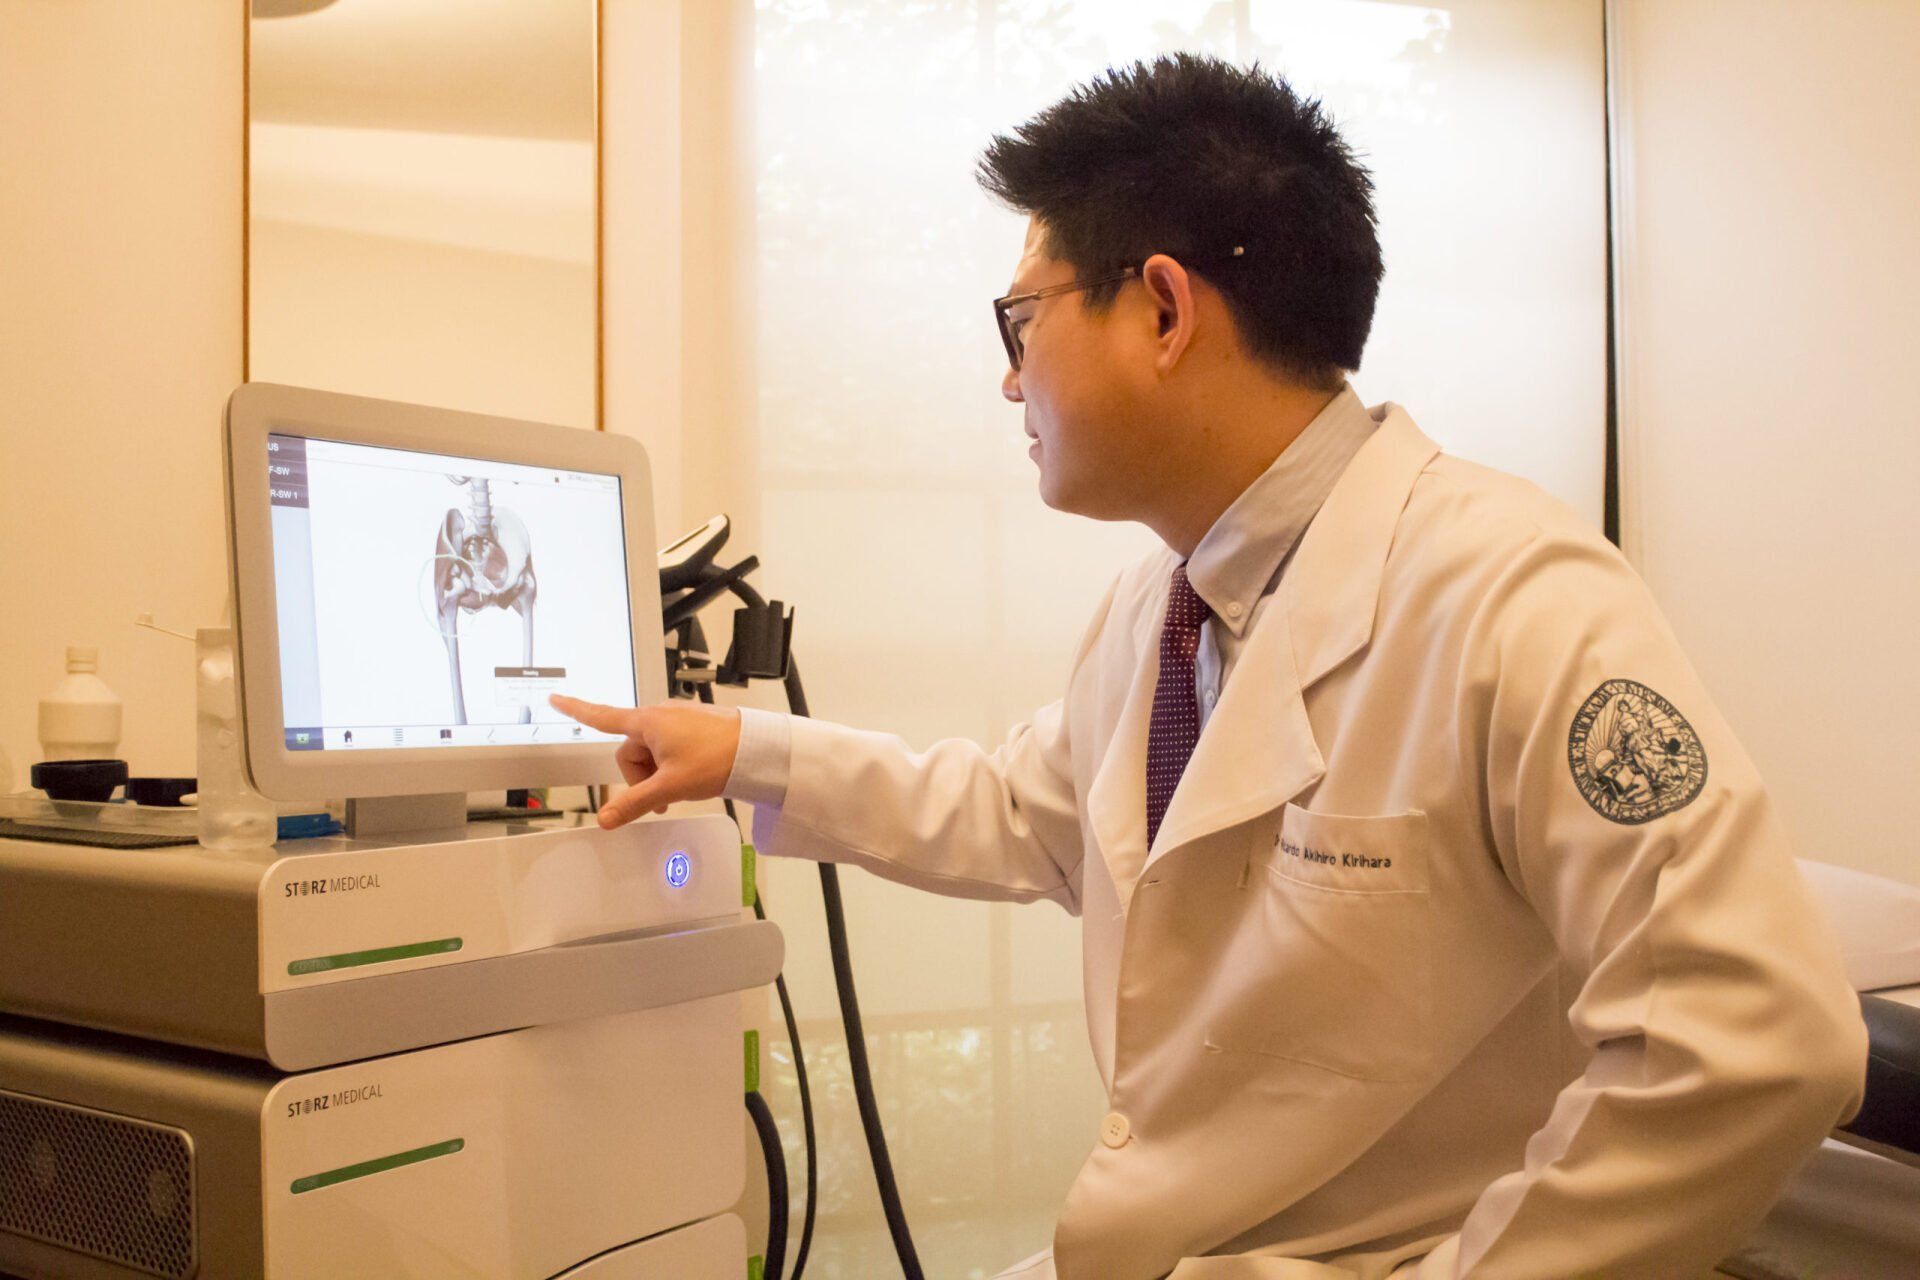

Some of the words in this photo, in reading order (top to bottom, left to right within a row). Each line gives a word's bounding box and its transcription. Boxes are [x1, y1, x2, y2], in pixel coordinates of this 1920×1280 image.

[1304, 847, 1336, 865] Akihiro
[1342, 853, 1392, 868] Kirihara
[285, 879, 327, 898] STORZ
[330, 874, 381, 893] MEDICAL
[287, 1095, 329, 1118] STORZ
[332, 1083, 384, 1107] MEDICAL
